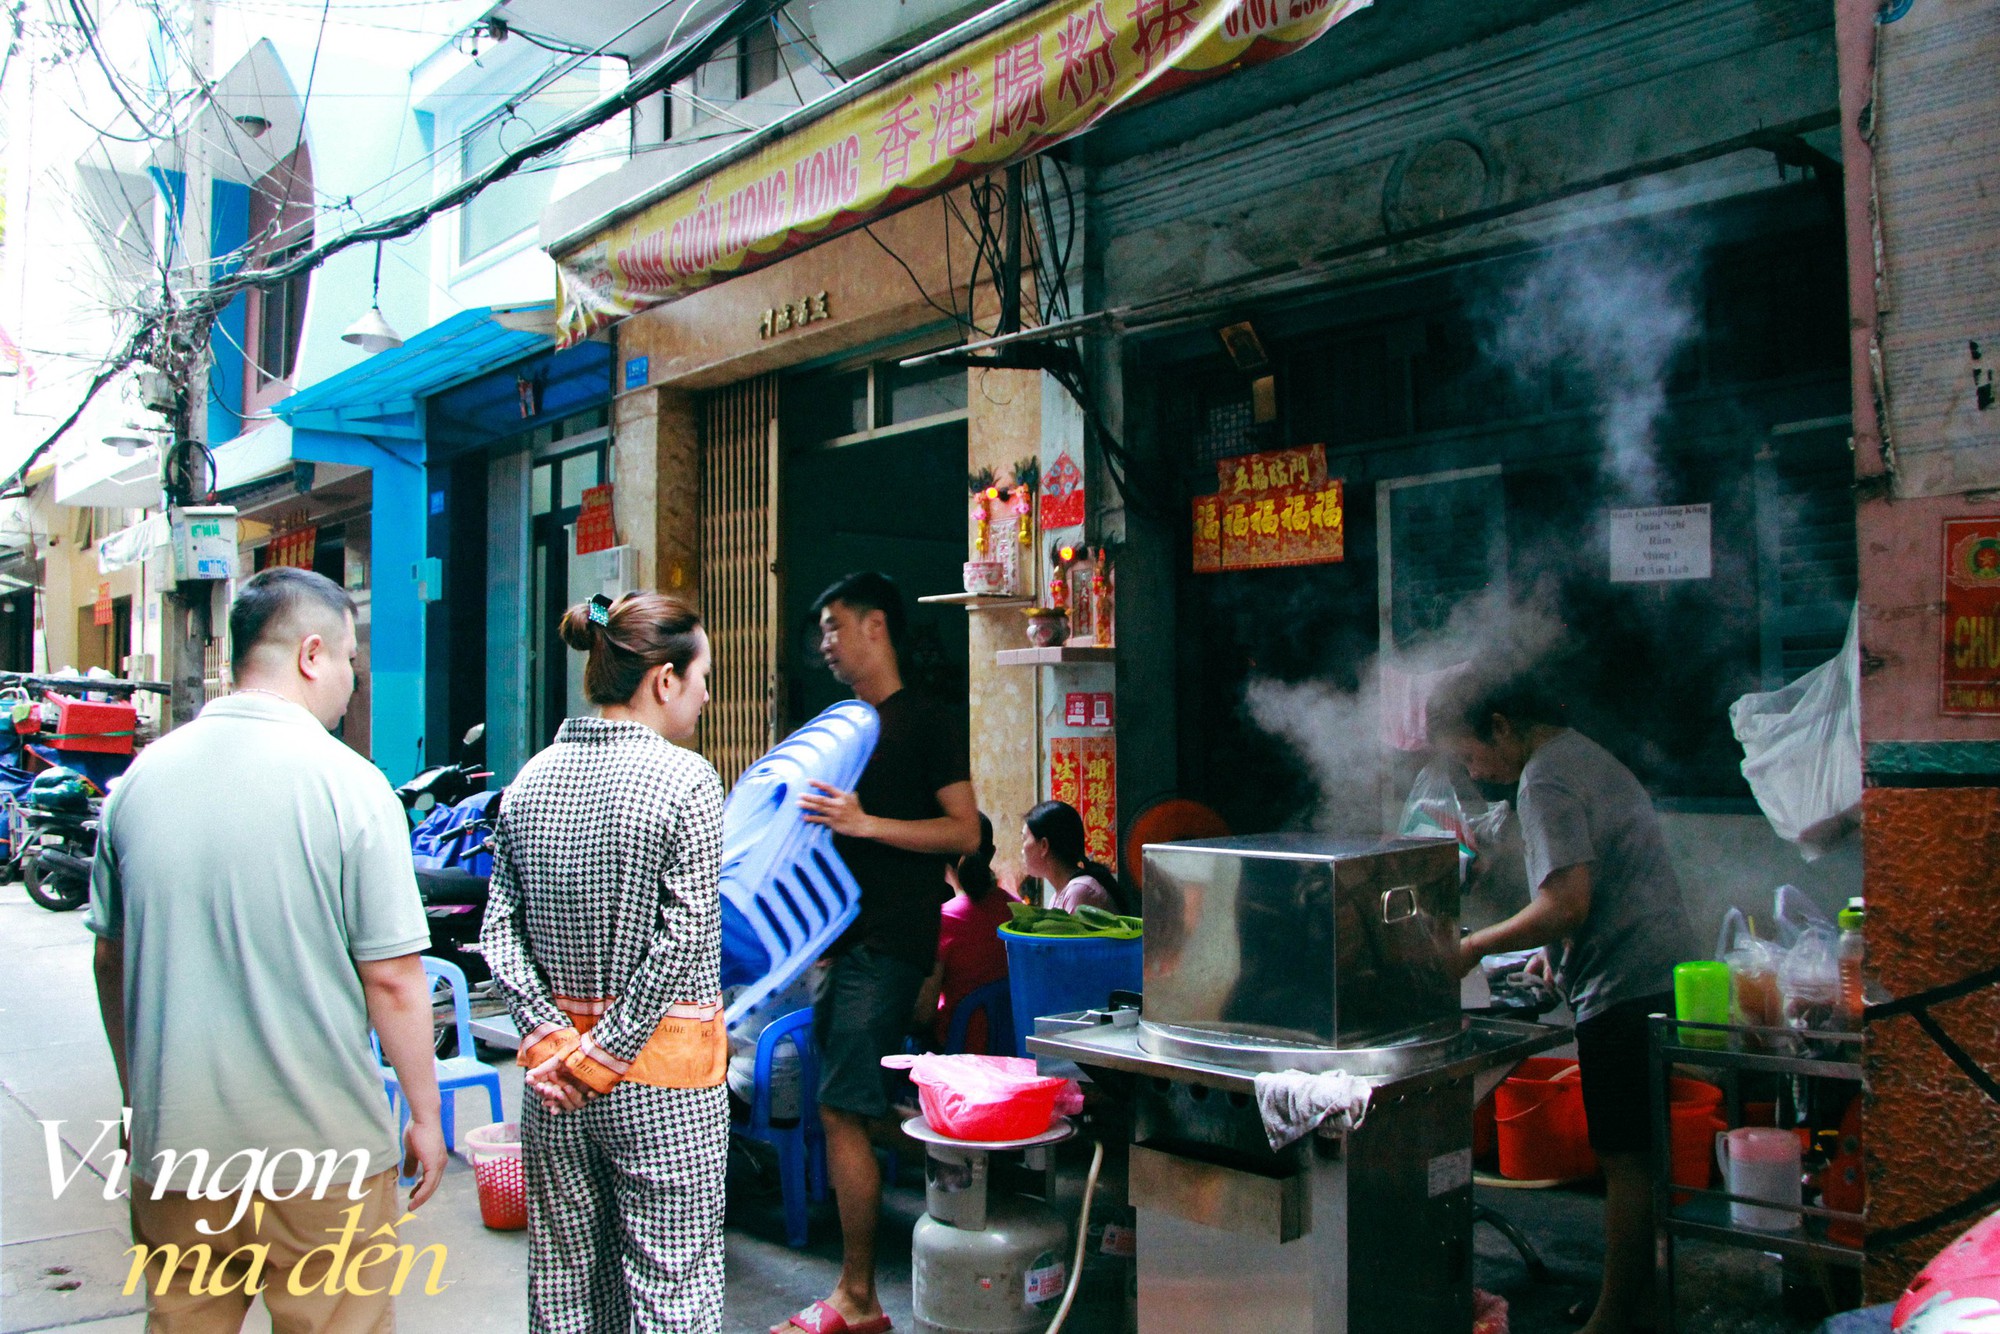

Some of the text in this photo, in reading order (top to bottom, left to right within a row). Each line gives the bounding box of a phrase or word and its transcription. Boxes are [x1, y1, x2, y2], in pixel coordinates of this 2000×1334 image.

[617, 134, 860, 295] BÁNH CUỐN HONG KONG
